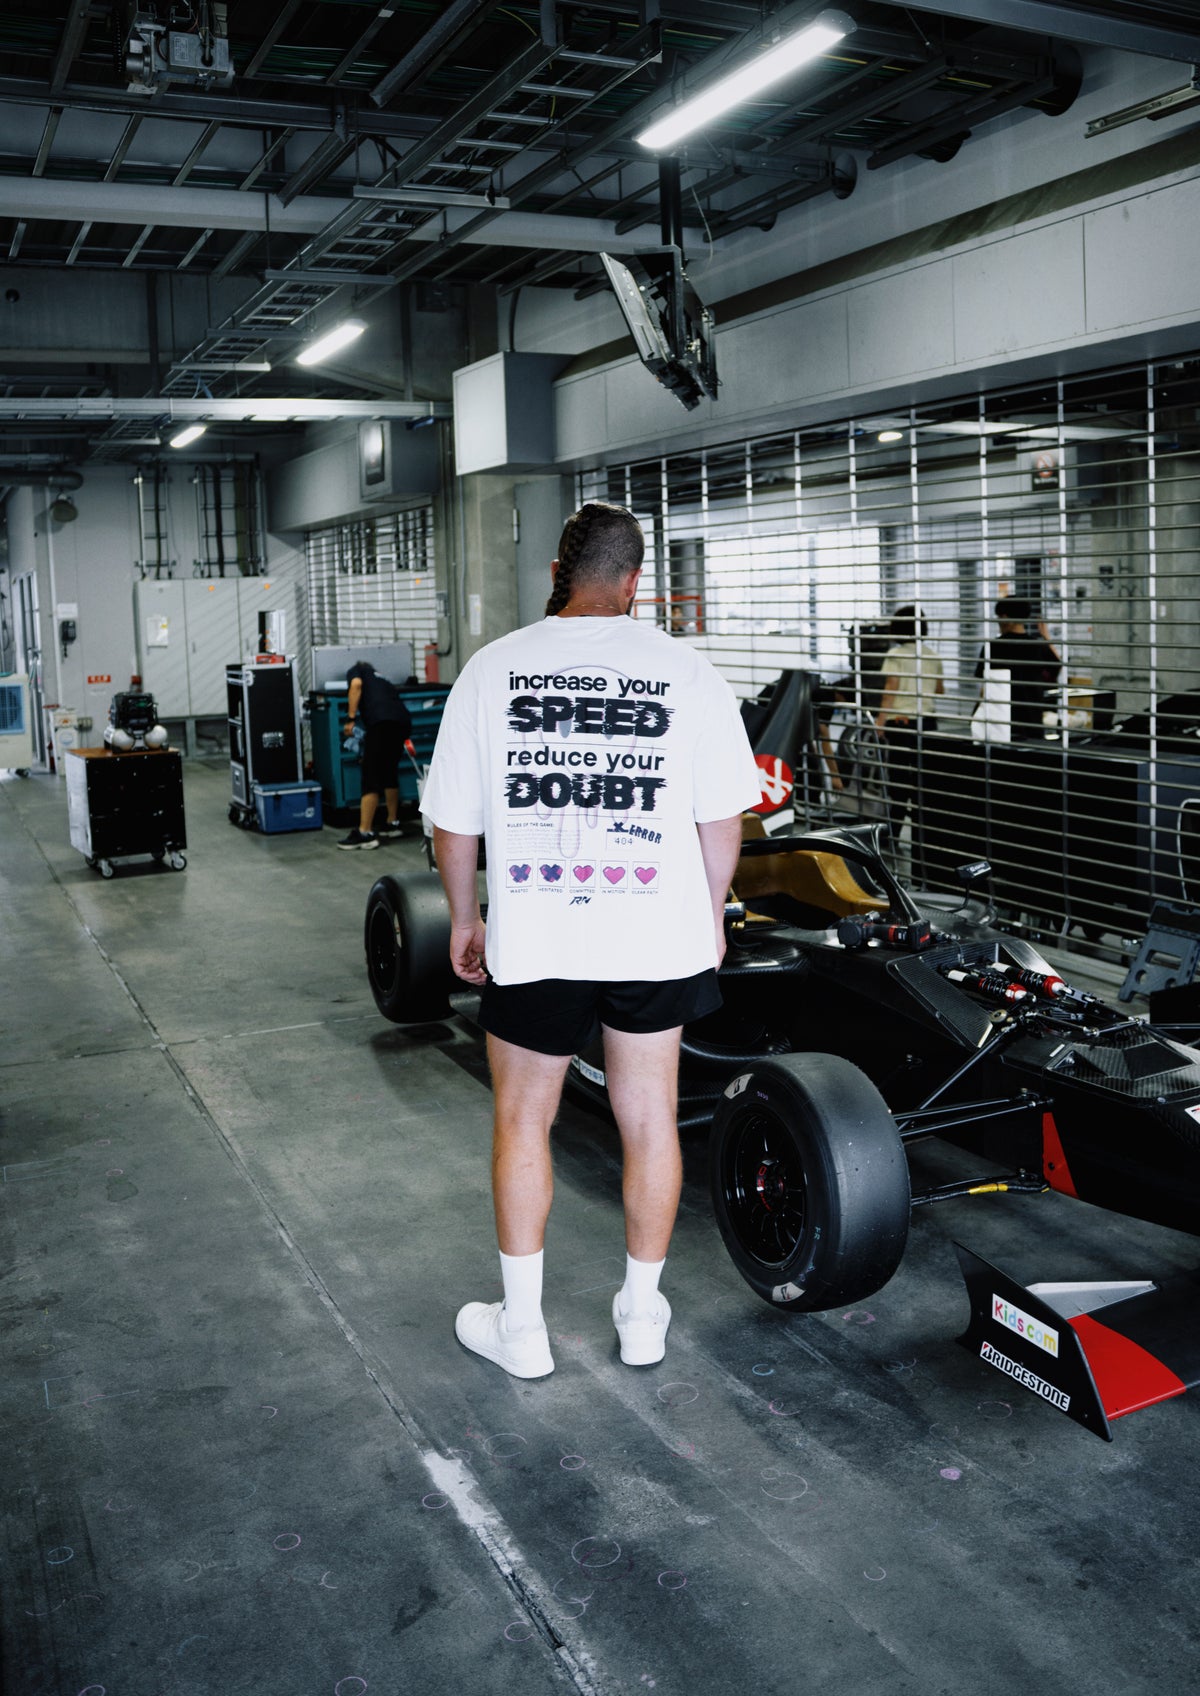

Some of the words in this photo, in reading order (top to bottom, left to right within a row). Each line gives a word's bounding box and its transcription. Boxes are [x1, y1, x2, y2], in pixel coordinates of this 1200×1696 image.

[509, 671, 607, 691] increase
[617, 677, 670, 698] your
[505, 695, 675, 738] SPEED
[507, 746, 597, 767] reduce
[606, 752, 665, 773] your
[504, 772, 668, 811] DOUBT
[615, 837, 633, 845] 404
[629, 824, 662, 844] ERROR
[981, 1342, 1069, 1410] BRIDGESTONE
